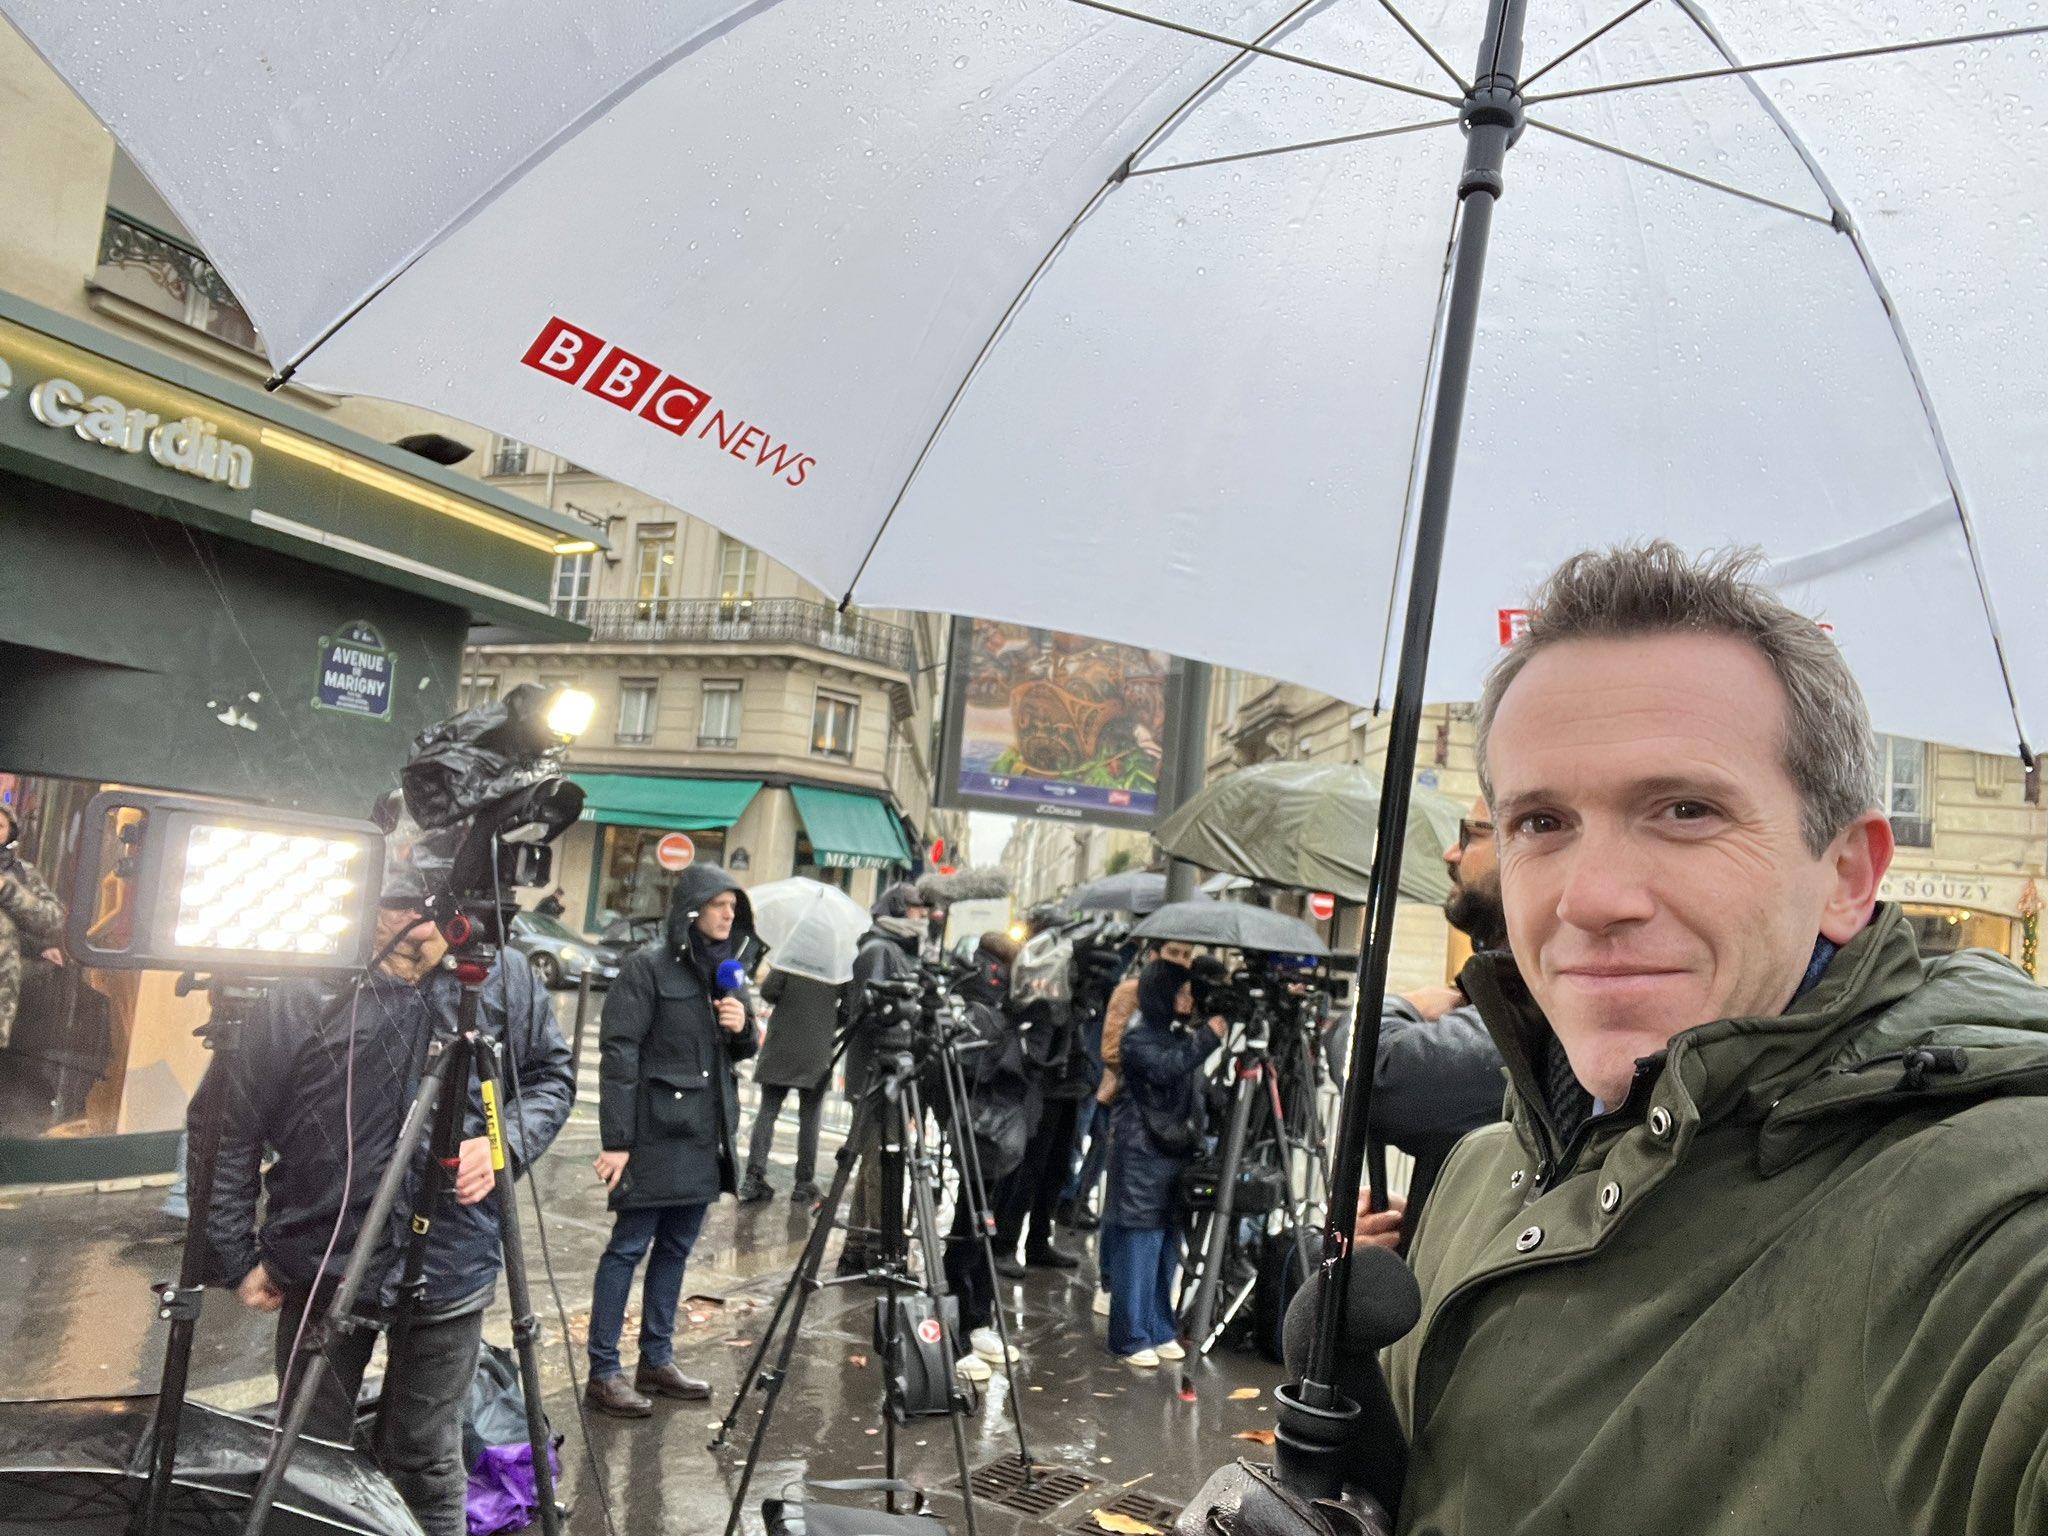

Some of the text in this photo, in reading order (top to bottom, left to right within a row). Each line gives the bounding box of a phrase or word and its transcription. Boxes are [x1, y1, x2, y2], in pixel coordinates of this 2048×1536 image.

[534, 325, 817, 488] BBC NEWS
[29, 377, 254, 490] cardin
[332, 646, 385, 673] AVENUE
[323, 669, 386, 698] MARIGNY
[1903, 880, 1993, 900] SOUZY
